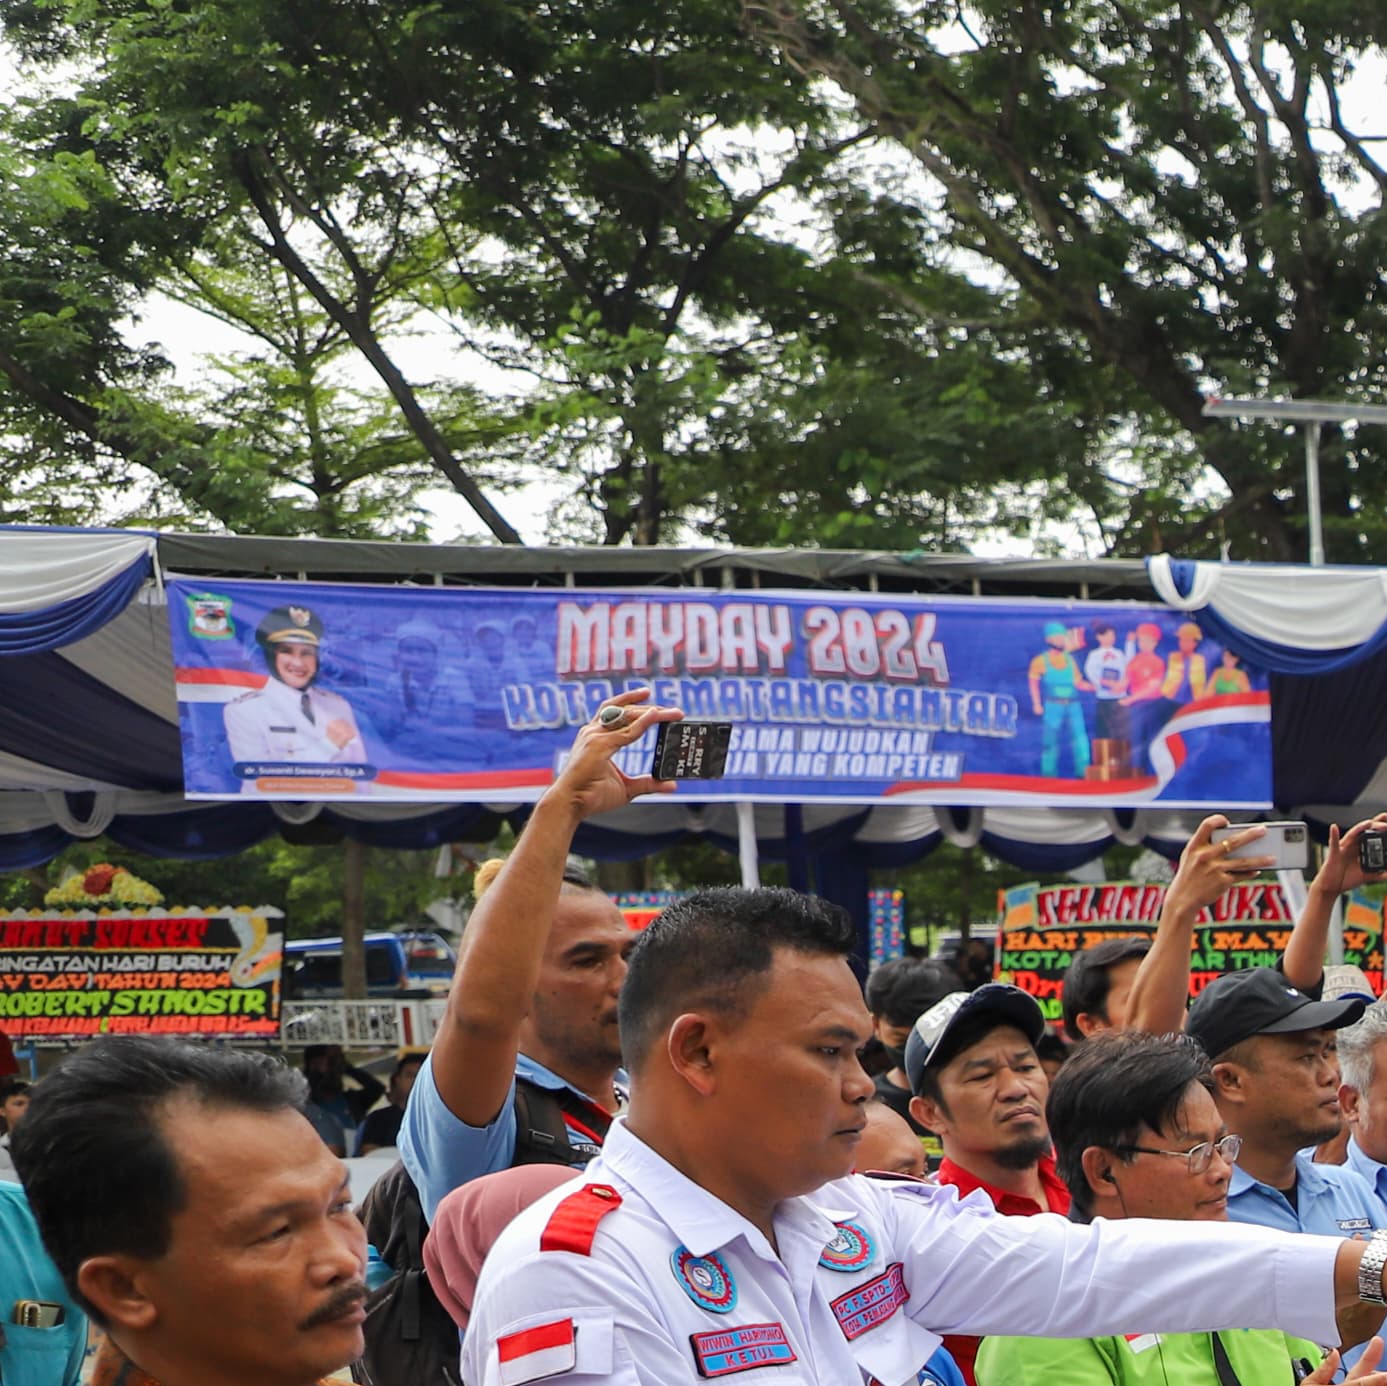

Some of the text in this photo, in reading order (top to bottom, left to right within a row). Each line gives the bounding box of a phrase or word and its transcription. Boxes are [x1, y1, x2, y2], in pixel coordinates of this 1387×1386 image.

[558, 600, 950, 686] MAYDAY 2024
[727, 727, 797, 753] SAMA
[800, 728, 929, 755] WUJUDKAN
[765, 753, 827, 778] YANG
[832, 753, 960, 779] KOMPETEN
[1037, 882, 1168, 927] SELAMA
[94, 917, 209, 949] SUKSES
[1004, 931, 1079, 950] HARI
[0, 954, 232, 972] INGATAN HARI BURUH
[1003, 953, 1073, 970] KOTA
[93, 972, 178, 989] TAHUN
[179, 972, 232, 989] 2024
[837, 1303, 853, 1316] PC
[724, 1346, 776, 1367] KETUA
